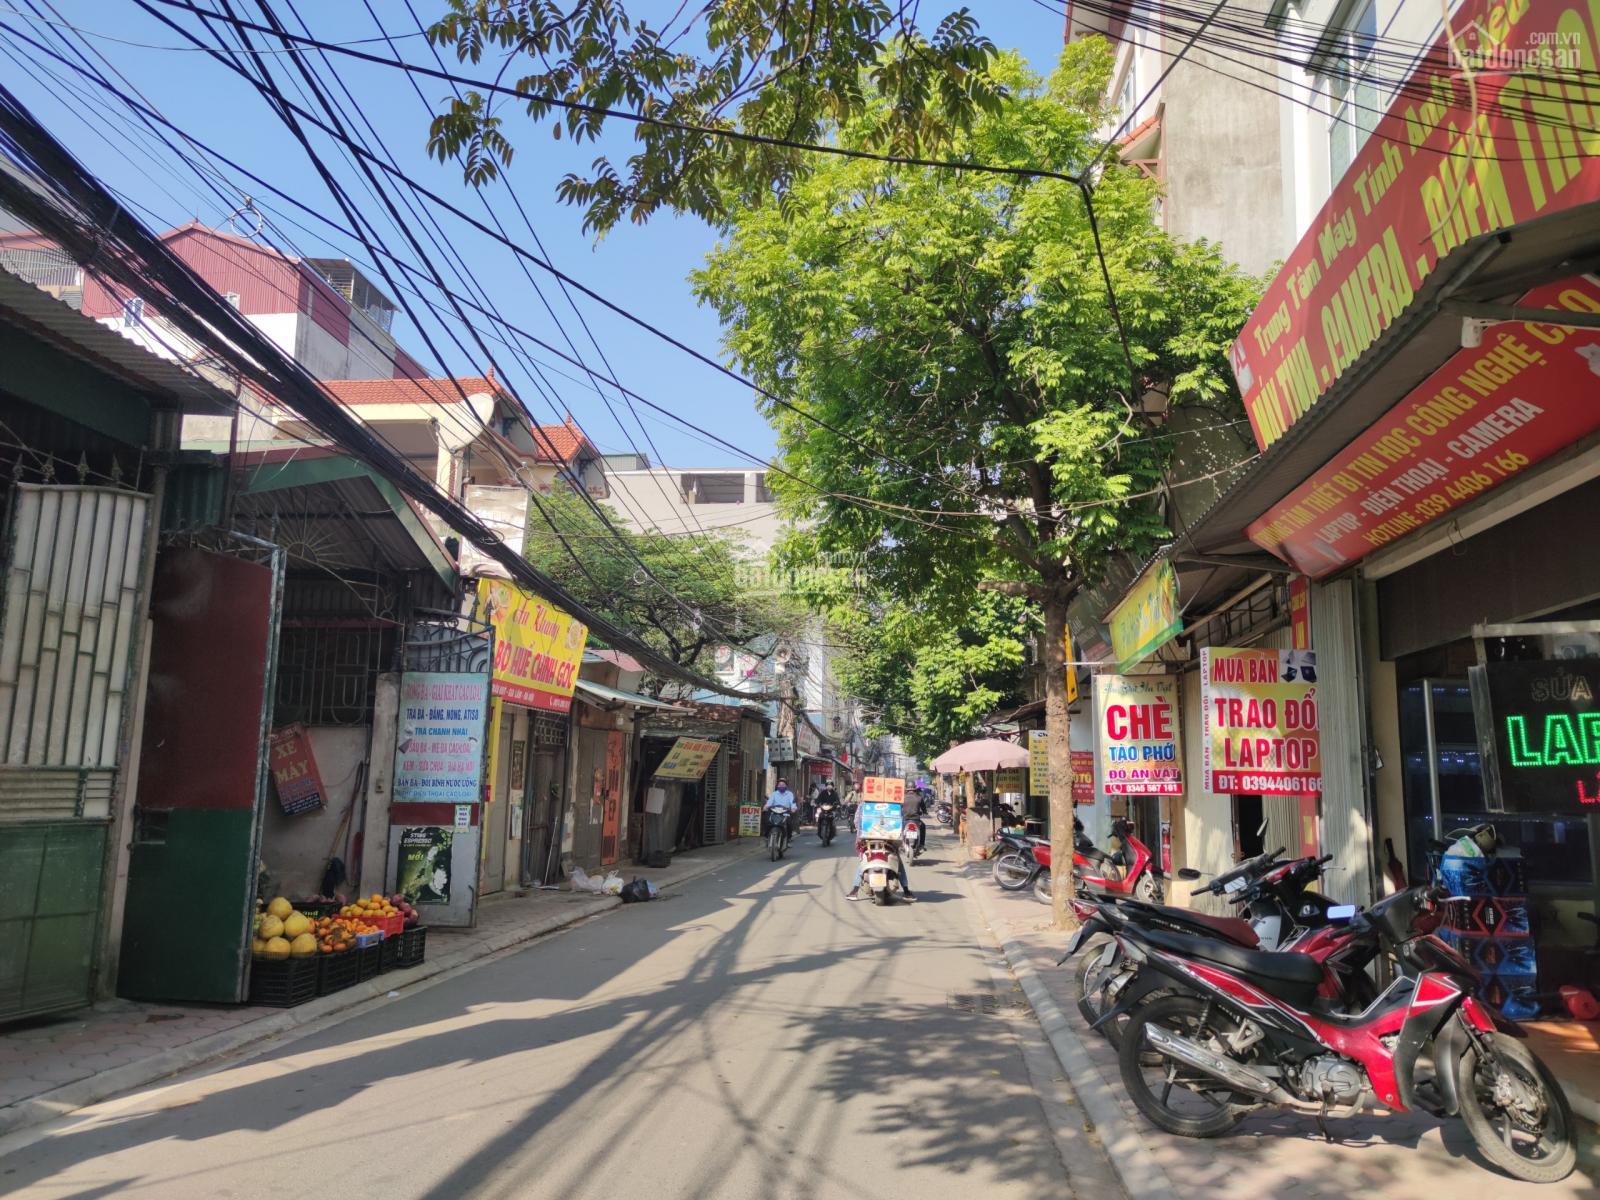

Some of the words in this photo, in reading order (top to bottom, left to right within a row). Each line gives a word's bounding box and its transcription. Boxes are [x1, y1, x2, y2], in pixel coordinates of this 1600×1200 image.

[1286, 258, 1322, 310] Tâm
[1318, 206, 1357, 270] Máy
[1353, 140, 1404, 217] Tính
[1347, 453, 1389, 480] TIN
[1372, 427, 1422, 464] HỌC
[1406, 385, 1478, 436] CÔNG
[1457, 332, 1547, 398] NGHỆ
[1314, 512, 1362, 544] LAPTOP
[1360, 484, 1405, 516] ĐIỆN
[1391, 457, 1450, 495] THOẠI
[1447, 397, 1545, 458] CAMERA
[1362, 511, 1423, 546] HOTLINE
[1445, 470, 1494, 500] 4406
[1482, 449, 1530, 477] 166
[1213, 658, 1245, 683] MUA
[1248, 652, 1278, 683] BÁN
[1106, 695, 1174, 741] CHÈ
[1215, 698, 1277, 729] TRAO
[1109, 743, 1138, 761] TÀO
[1224, 737, 1317, 769] LAPTOP
[1218, 775, 1239, 790] ĐT:
